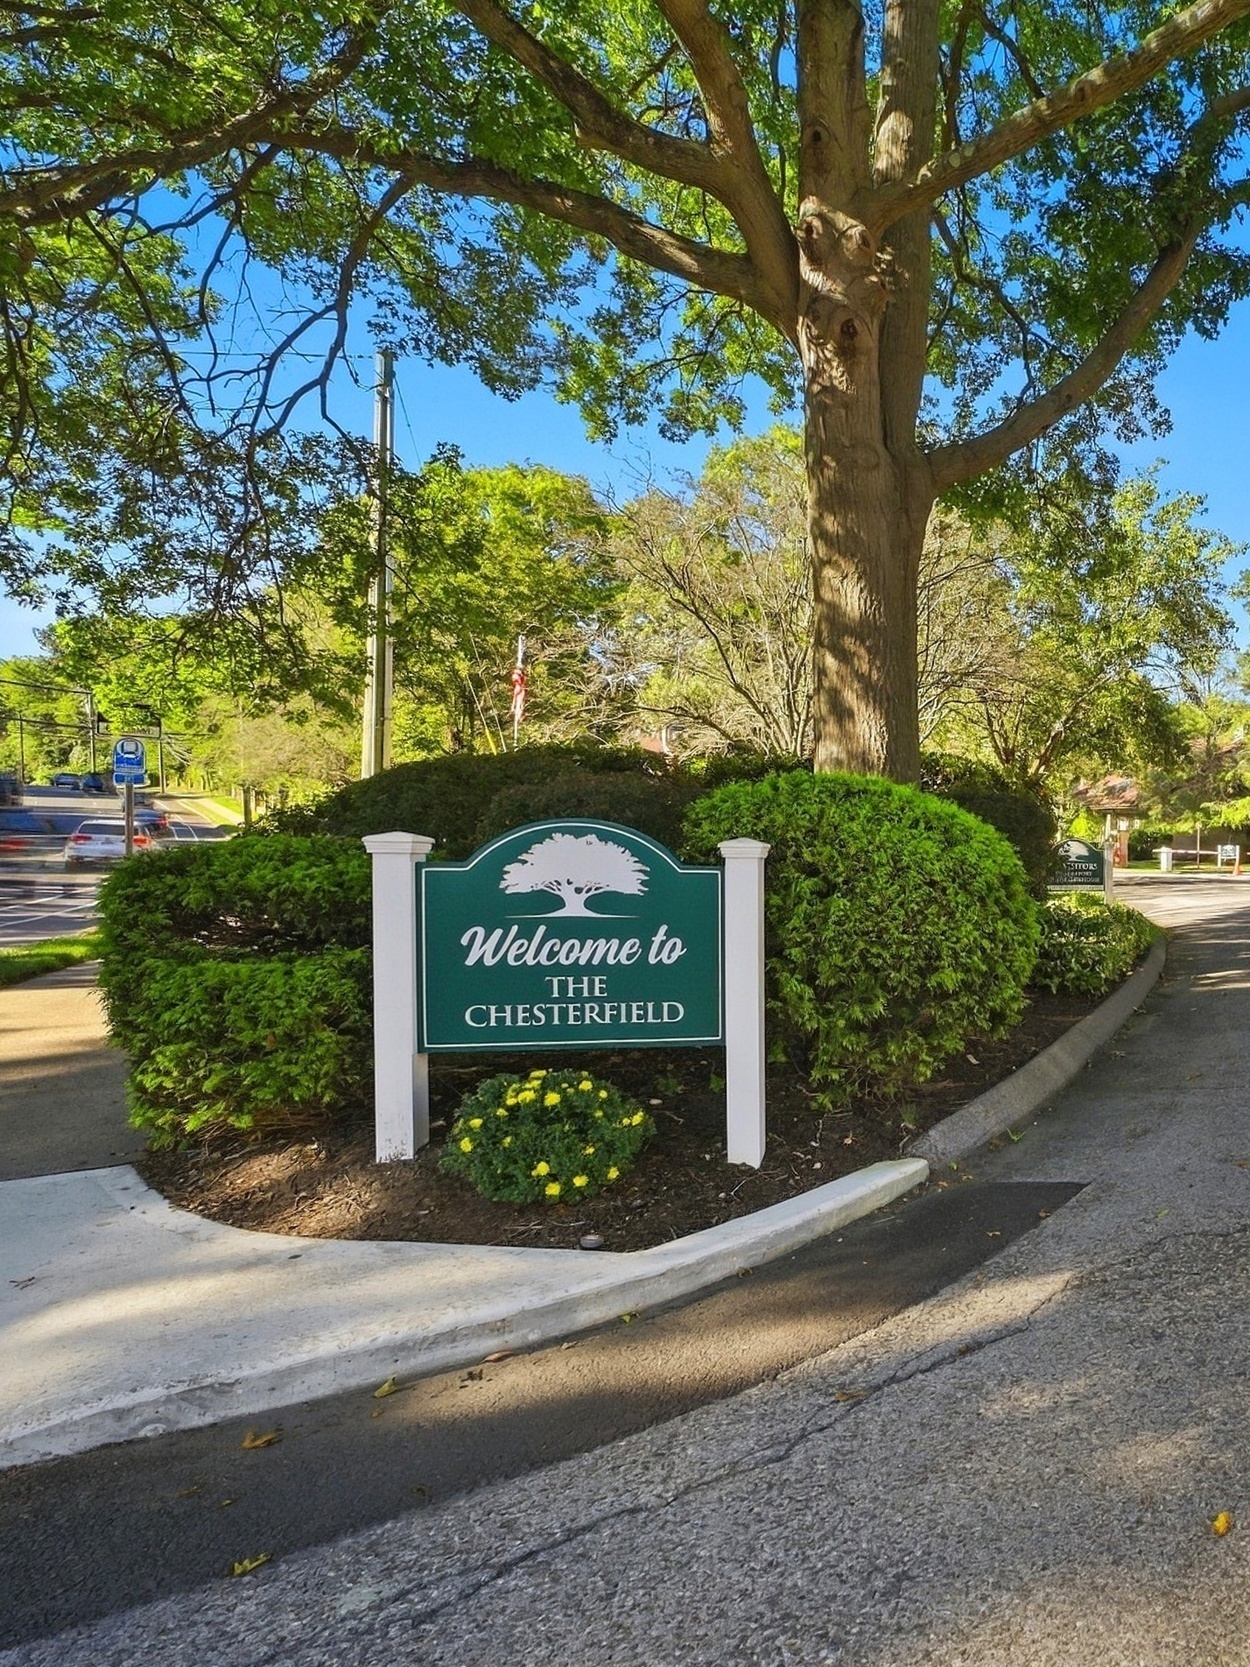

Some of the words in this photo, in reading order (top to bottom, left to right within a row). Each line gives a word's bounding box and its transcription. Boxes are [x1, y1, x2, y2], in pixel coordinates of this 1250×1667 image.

[460, 924, 642, 966] Welcome
[647, 924, 687, 965] to
[545, 975, 608, 998] THE
[464, 1001, 685, 1028] CHESTERFIELD
